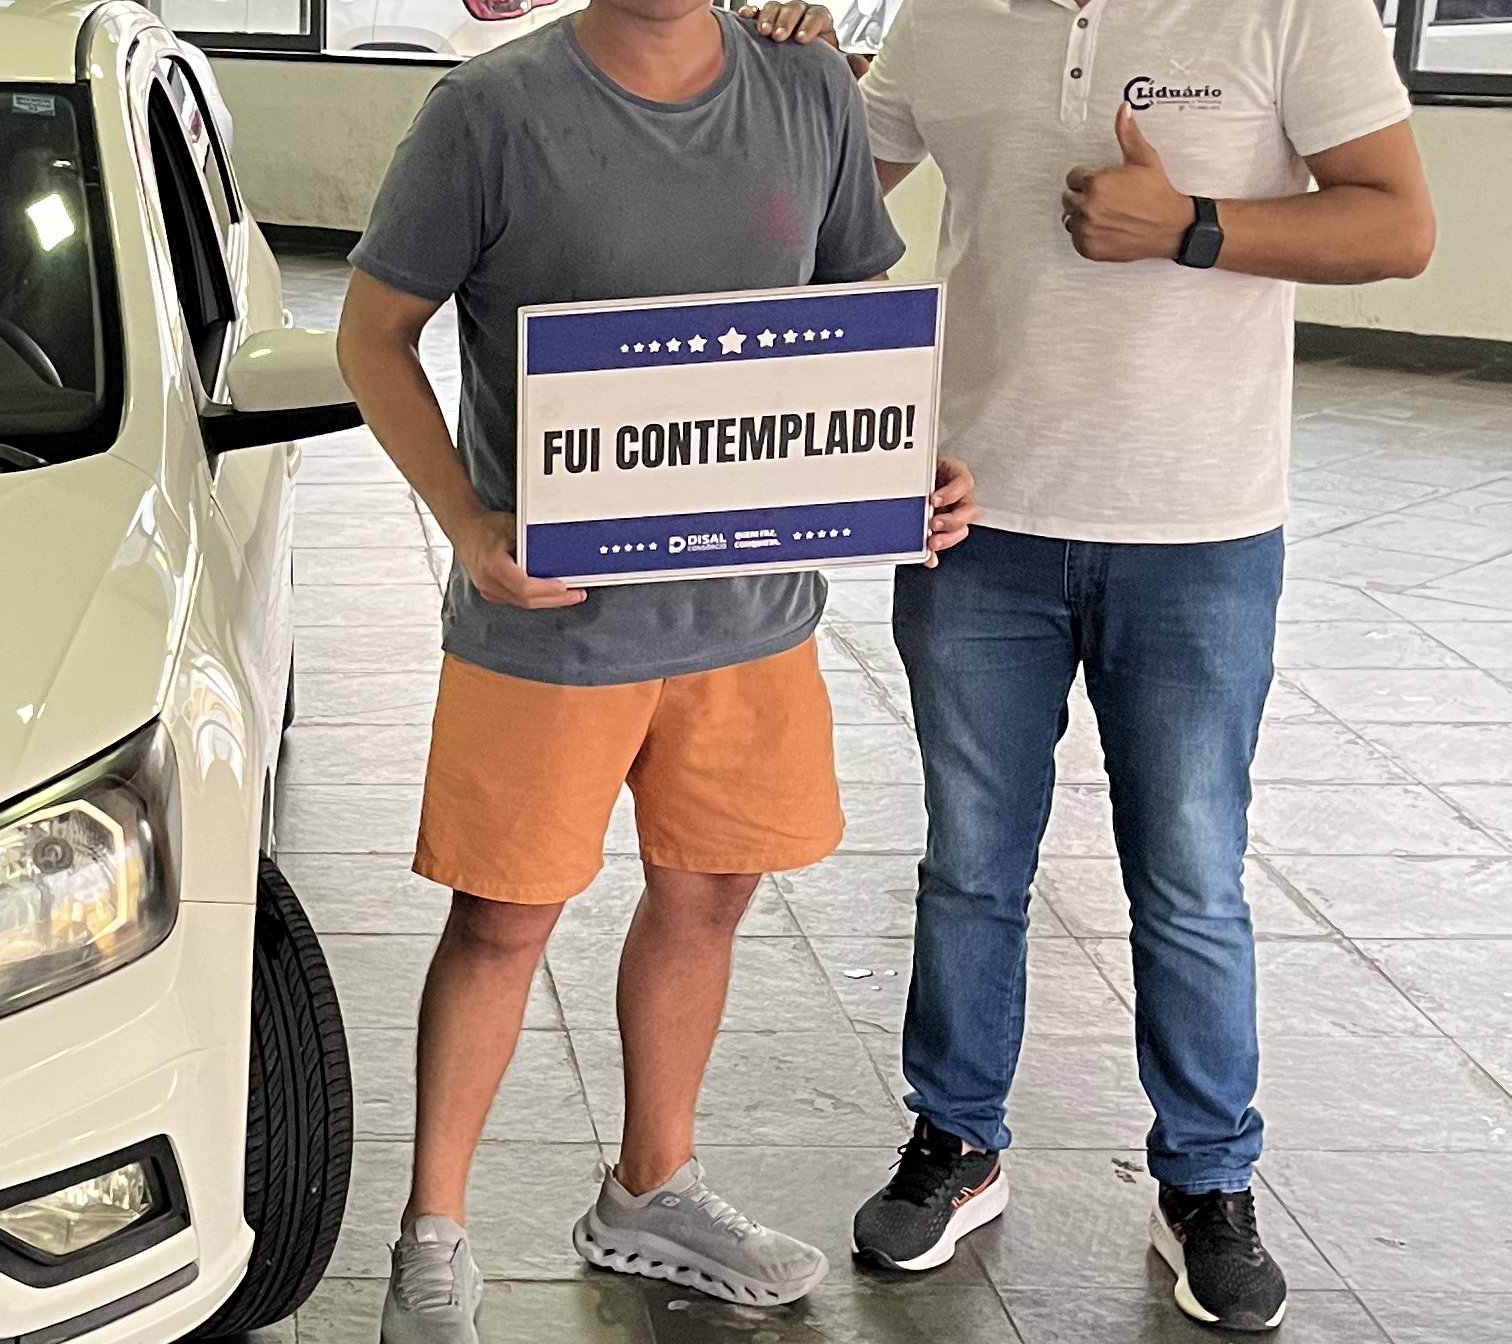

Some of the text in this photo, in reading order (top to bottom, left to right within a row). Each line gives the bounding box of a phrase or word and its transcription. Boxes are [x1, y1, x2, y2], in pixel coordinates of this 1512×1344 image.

[1136, 85, 1222, 100] Liduário
[543, 404, 917, 476] FUI CONTEMPLADO!
[688, 533, 727, 545] DISAL
